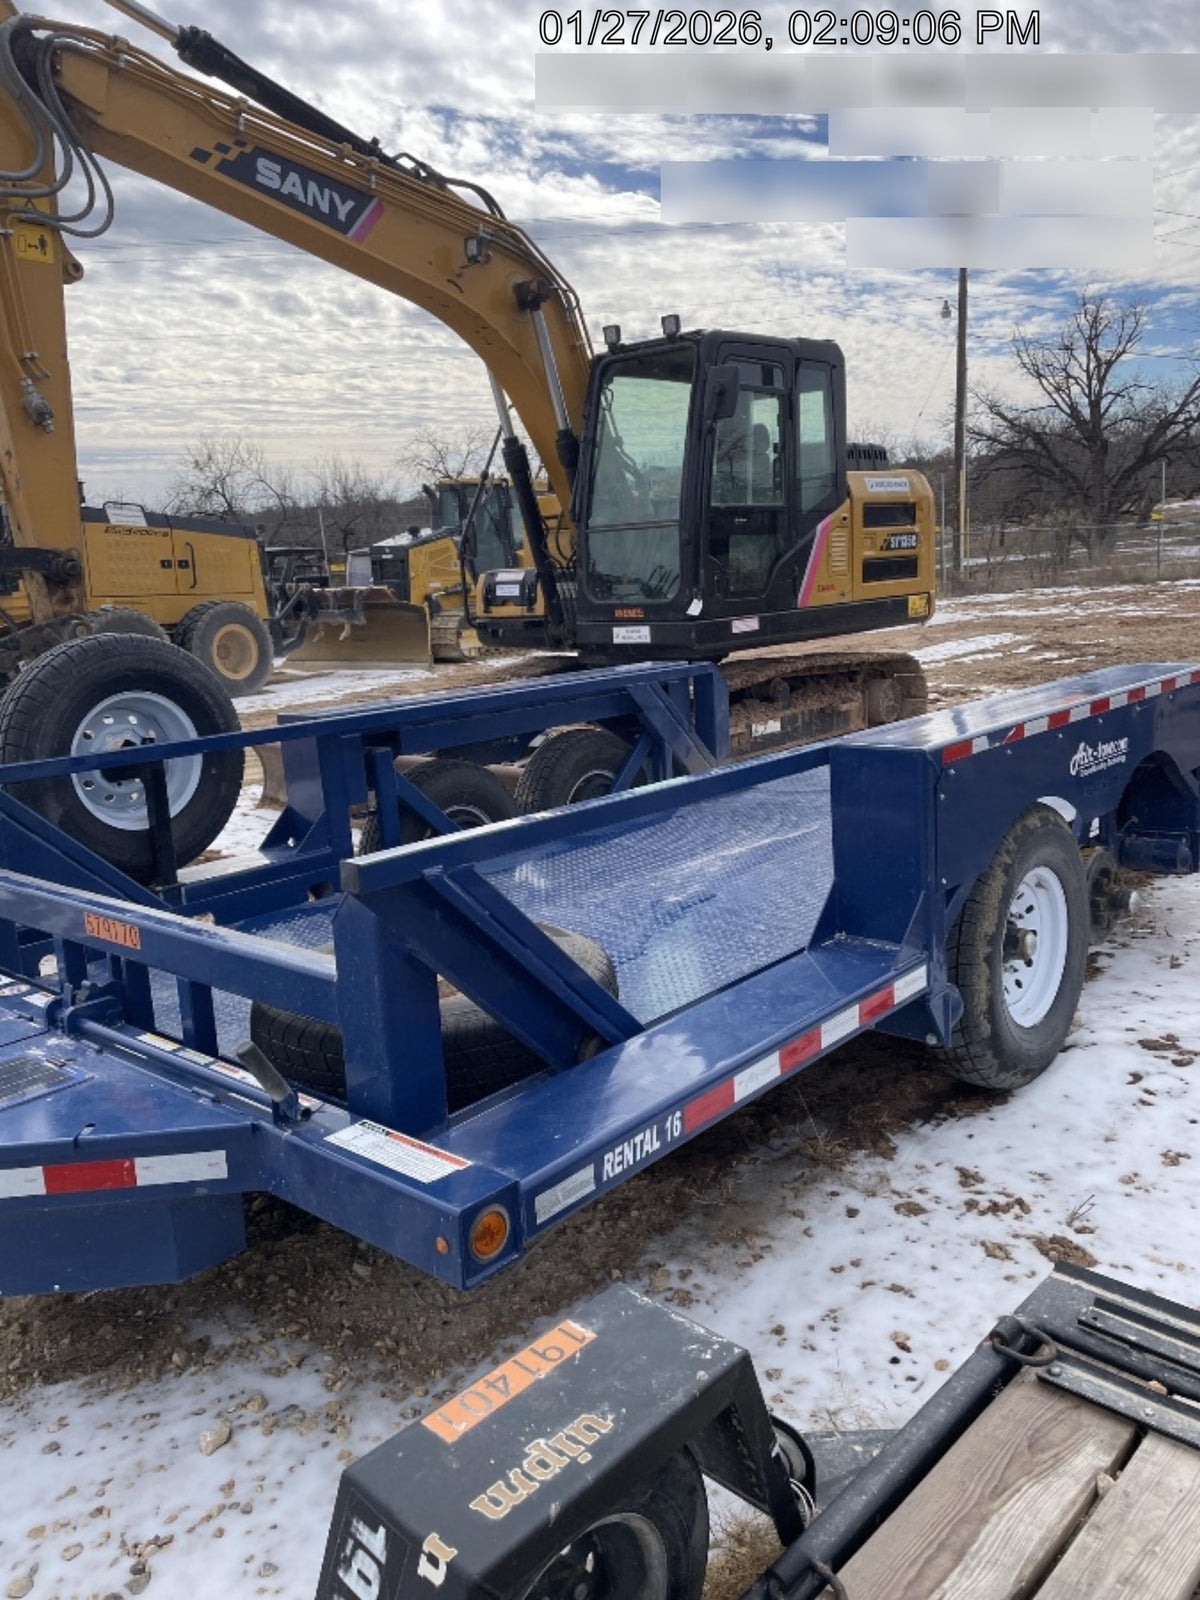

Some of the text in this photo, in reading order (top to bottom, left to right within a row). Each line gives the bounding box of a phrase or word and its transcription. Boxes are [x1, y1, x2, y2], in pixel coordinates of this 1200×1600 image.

[255, 157, 357, 223] SANY
[602, 1110, 682, 1183] RENTAL 16
[436, 1327, 588, 1432] 191401
